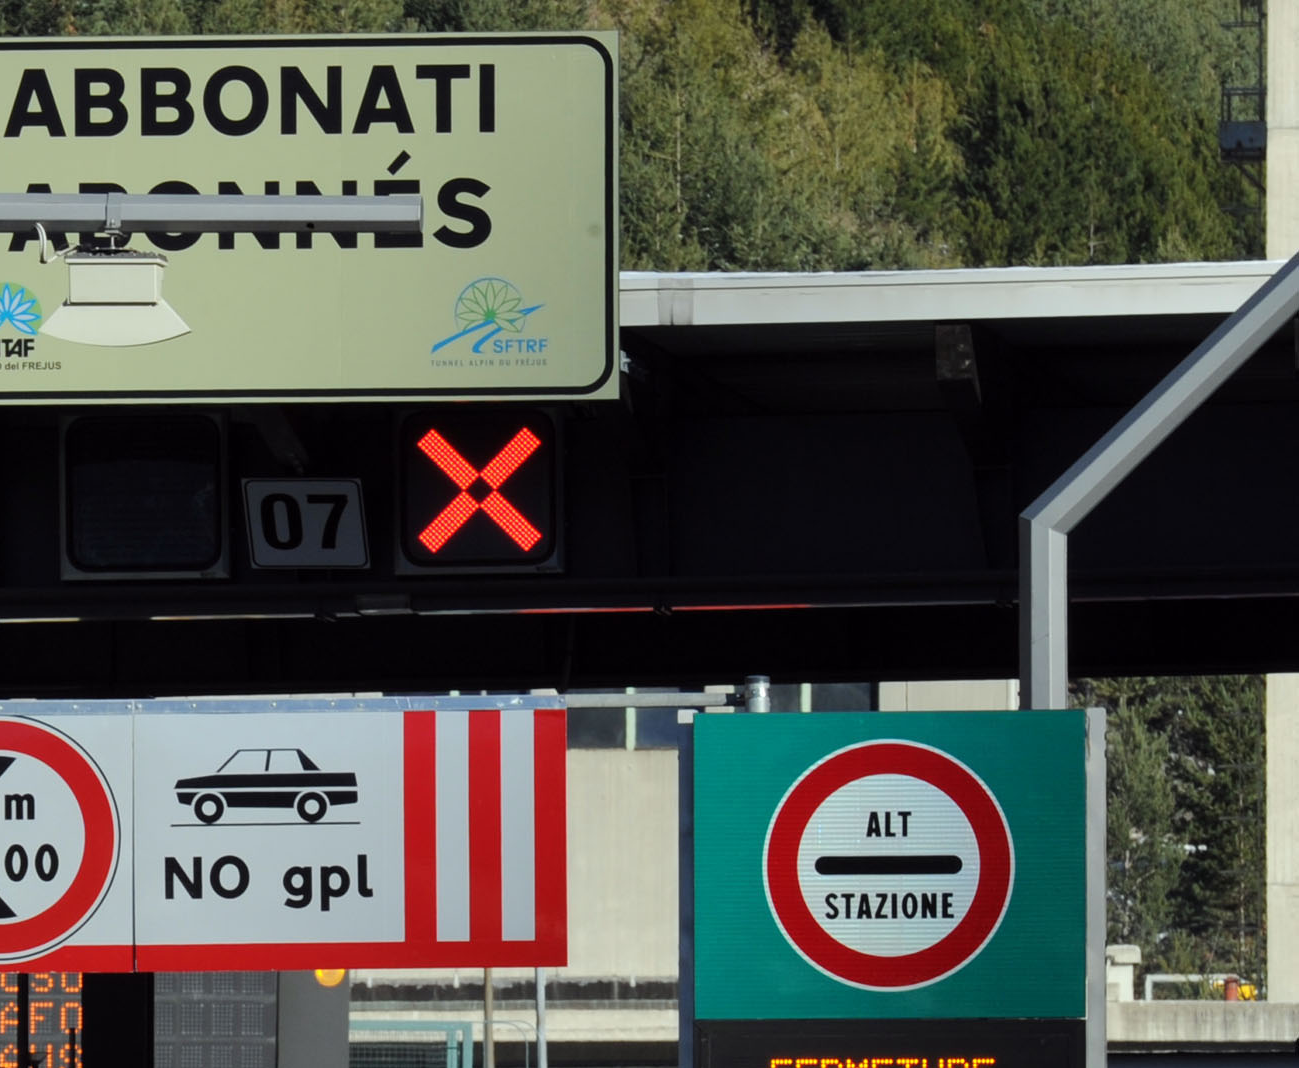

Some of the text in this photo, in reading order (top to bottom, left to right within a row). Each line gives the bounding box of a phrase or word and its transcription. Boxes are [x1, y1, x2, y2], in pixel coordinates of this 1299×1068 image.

[4, 63, 496, 138] ABBONATI
[493, 338, 548, 354] SFTRF
[4, 361, 20, 371] del
[22, 361, 62, 370] FREJUS
[260, 491, 349, 551] 07
[4, 793, 35, 821] m
[866, 810, 913, 839] ALT
[164, 854, 374, 911] NO gpl
[824, 892, 955, 921] STAZIONE
